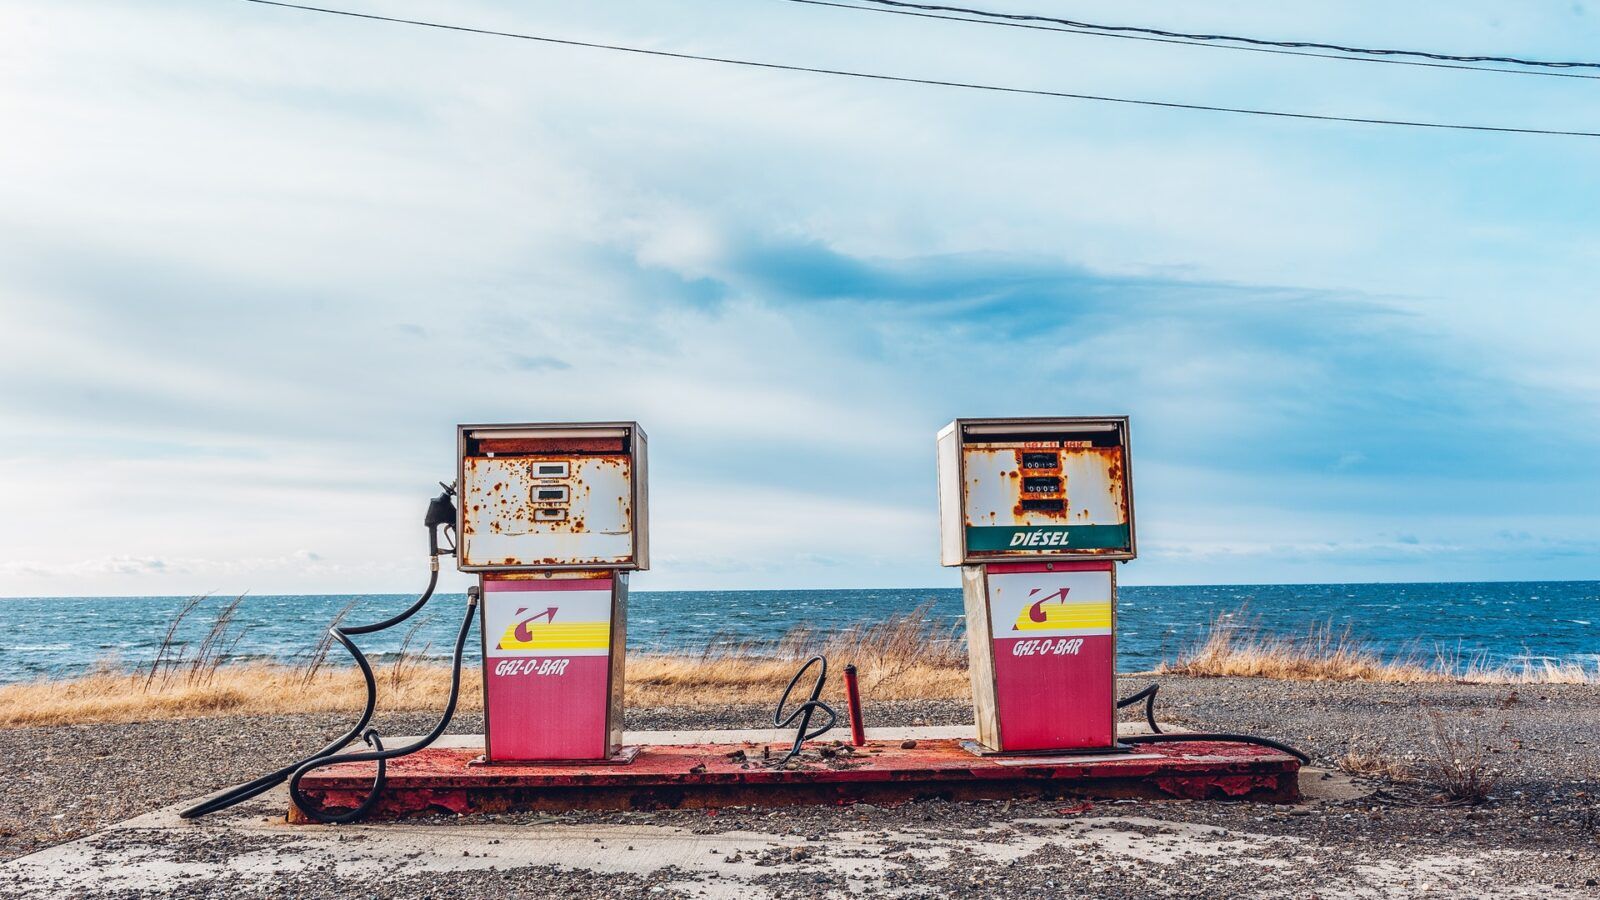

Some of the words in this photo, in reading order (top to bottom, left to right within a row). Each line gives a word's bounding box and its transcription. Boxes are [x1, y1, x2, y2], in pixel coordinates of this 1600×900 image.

[1009, 529, 1069, 547] DIÉSEL
[1012, 638, 1084, 657] GAZ-O-BAR
[495, 658, 570, 677] GAZ-O-BAR
